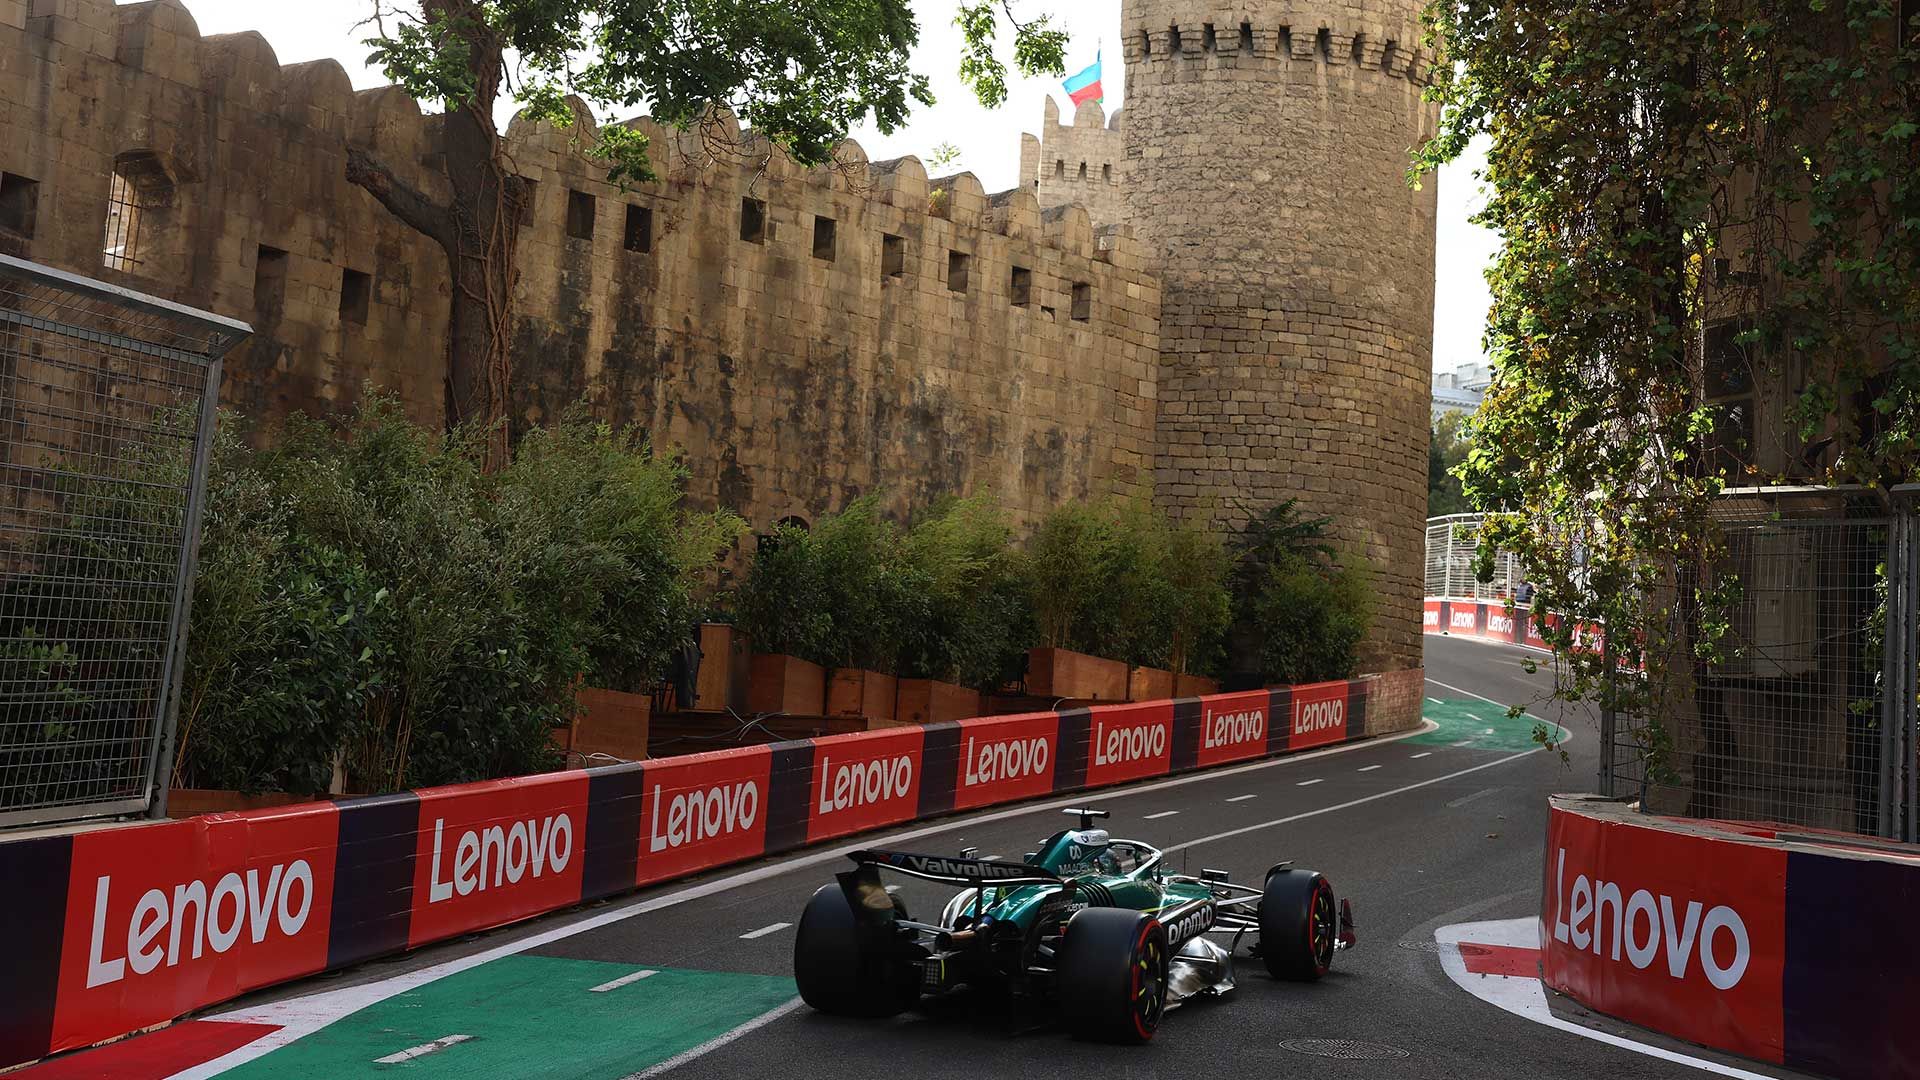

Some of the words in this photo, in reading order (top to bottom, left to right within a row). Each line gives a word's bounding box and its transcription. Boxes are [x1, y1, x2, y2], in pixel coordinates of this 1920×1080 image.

[1424, 610, 1439, 626] novo
[1451, 607, 1475, 628] Lenovo
[1487, 610, 1513, 633] Lenovo
[1206, 710, 1262, 747] Lenovo
[1296, 700, 1342, 733] Lenovo
[966, 737, 1047, 785] Lenovo
[1096, 723, 1164, 765] Lenovo
[820, 756, 911, 814] Lenovo
[651, 782, 757, 852] Lenovo
[430, 814, 571, 902] Lenovo
[909, 856, 1024, 877] Valvoline
[86, 859, 313, 988] Lenovo
[1168, 905, 1213, 945] aramco
[1554, 848, 1750, 990] Lenovo
